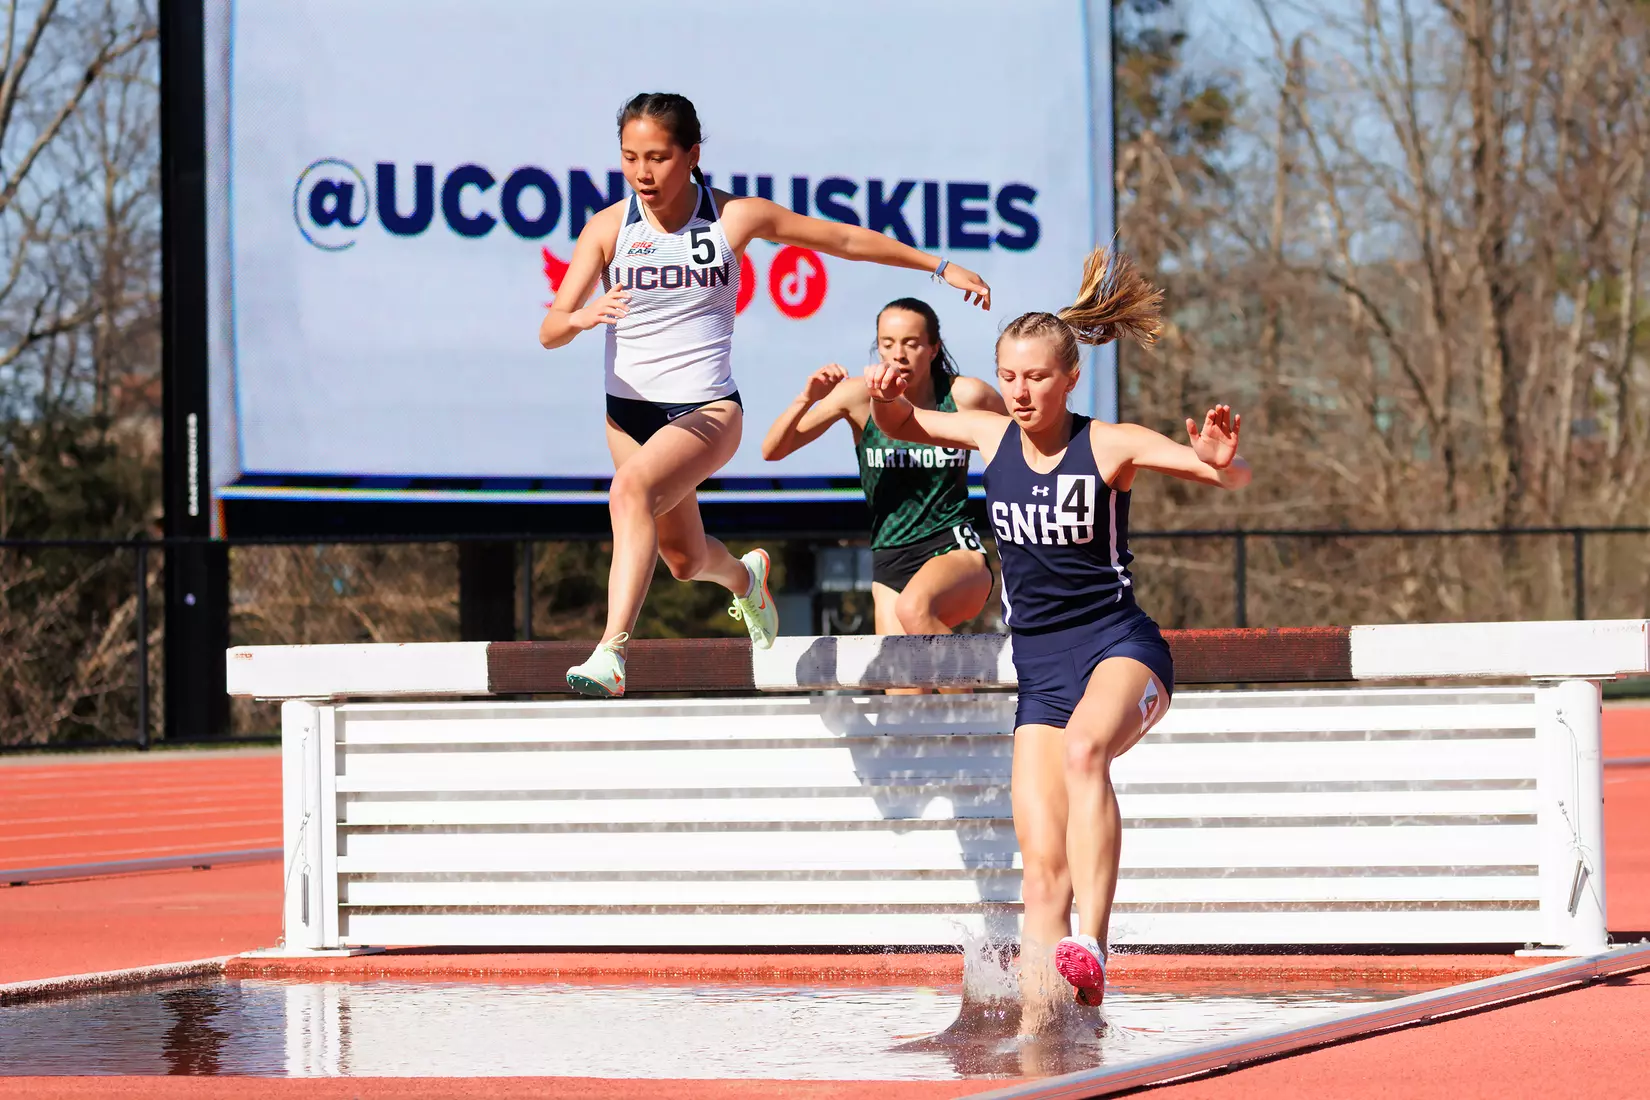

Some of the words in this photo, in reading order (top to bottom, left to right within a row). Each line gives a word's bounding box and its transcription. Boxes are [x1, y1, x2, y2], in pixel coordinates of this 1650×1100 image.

[293, 157, 1041, 252] @UCONSKIES
[627, 247, 659, 256] EAST
[631, 240, 655, 249] BIG
[689, 226, 716, 265] 5
[614, 263, 730, 291] UCONN
[865, 447, 967, 469] DARTMOUH
[1061, 478, 1090, 523] 4
